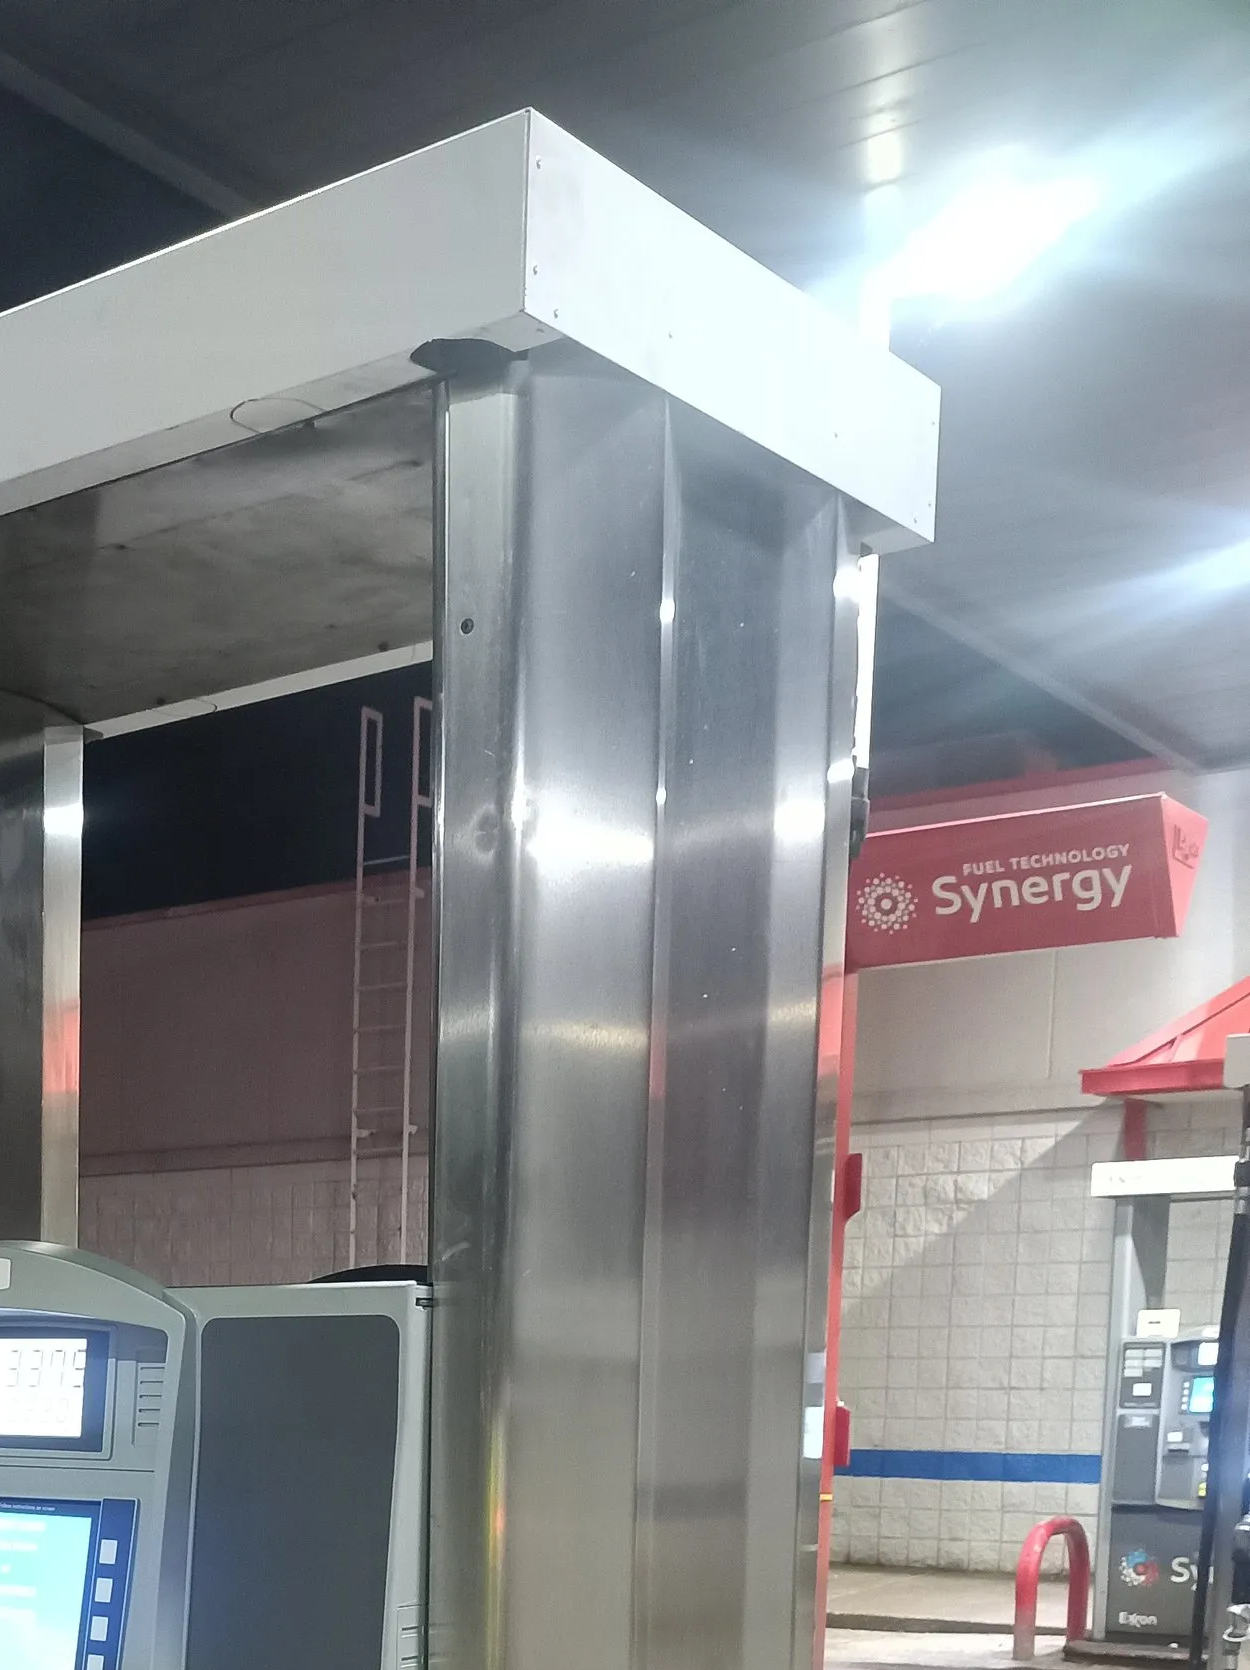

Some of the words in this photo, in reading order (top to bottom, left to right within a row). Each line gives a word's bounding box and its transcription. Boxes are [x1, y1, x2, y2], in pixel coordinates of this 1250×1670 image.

[962, 859, 1004, 876] FUEL
[1009, 843, 1130, 870] TECHNOLOGY
[932, 866, 1132, 923] Synergy
